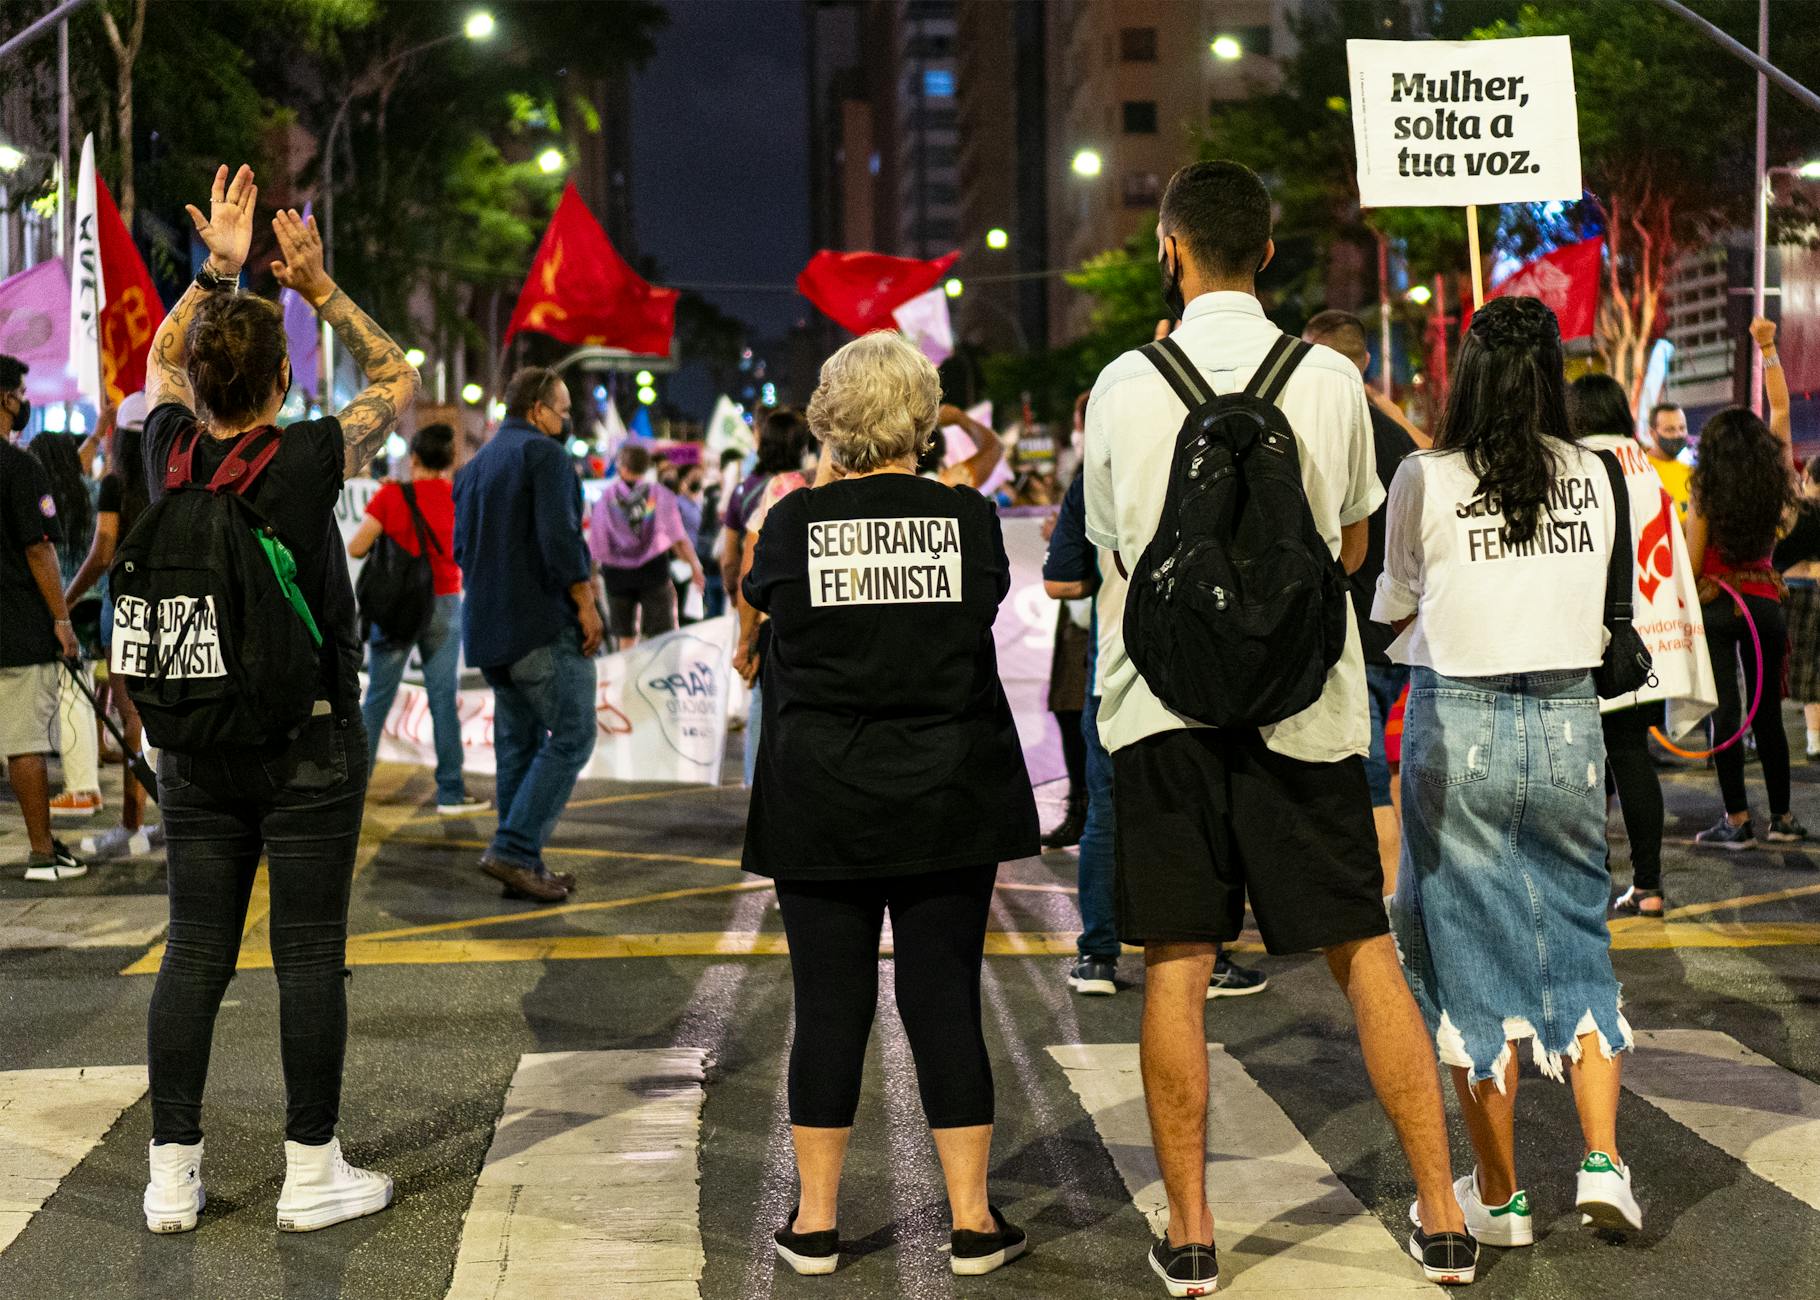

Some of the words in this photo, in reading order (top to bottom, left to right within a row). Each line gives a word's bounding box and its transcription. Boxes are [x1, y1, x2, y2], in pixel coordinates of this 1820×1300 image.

[1390, 70, 1529, 107] Mulher,
[1394, 108, 1481, 140] solta
[1490, 114, 1513, 138] a
[1398, 147, 1456, 177] tua
[1465, 150, 1540, 176] voz.
[1456, 478, 1599, 518] SEGNÇA
[810, 520, 958, 559] SEGURANÇA
[820, 565, 951, 602] FEMINISTA
